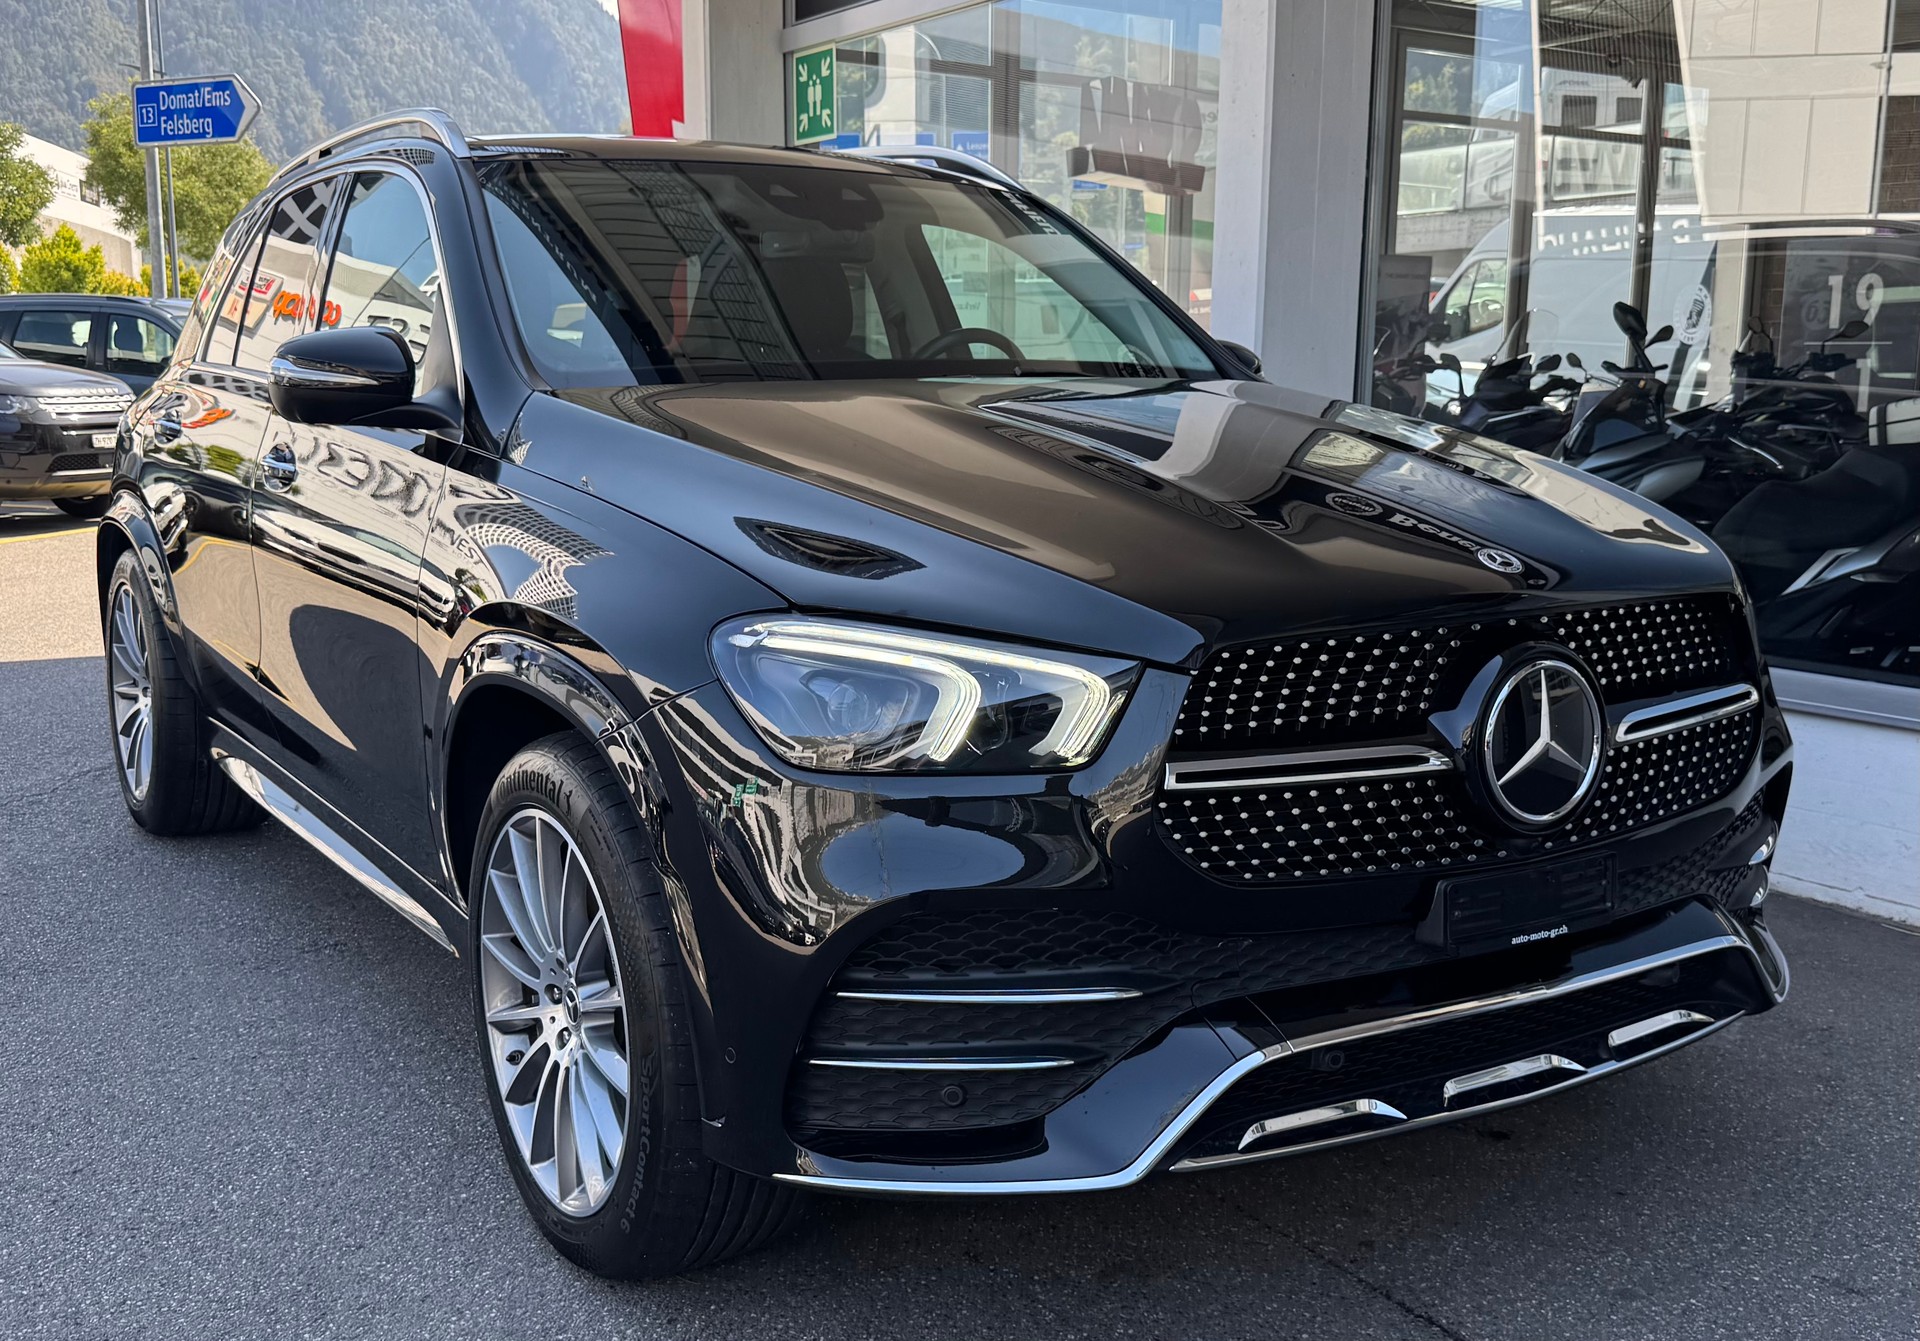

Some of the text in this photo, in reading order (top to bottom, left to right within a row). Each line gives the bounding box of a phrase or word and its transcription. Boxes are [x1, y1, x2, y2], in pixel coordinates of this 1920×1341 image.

[159, 87, 231, 111] Domat/Ems
[141, 106, 154, 123] 13
[160, 113, 213, 138] Felsberg
[1828, 273, 1884, 329] 19
[496, 763, 564, 810] Continental
[1511, 924, 1568, 945] auto-moto-gr.ch
